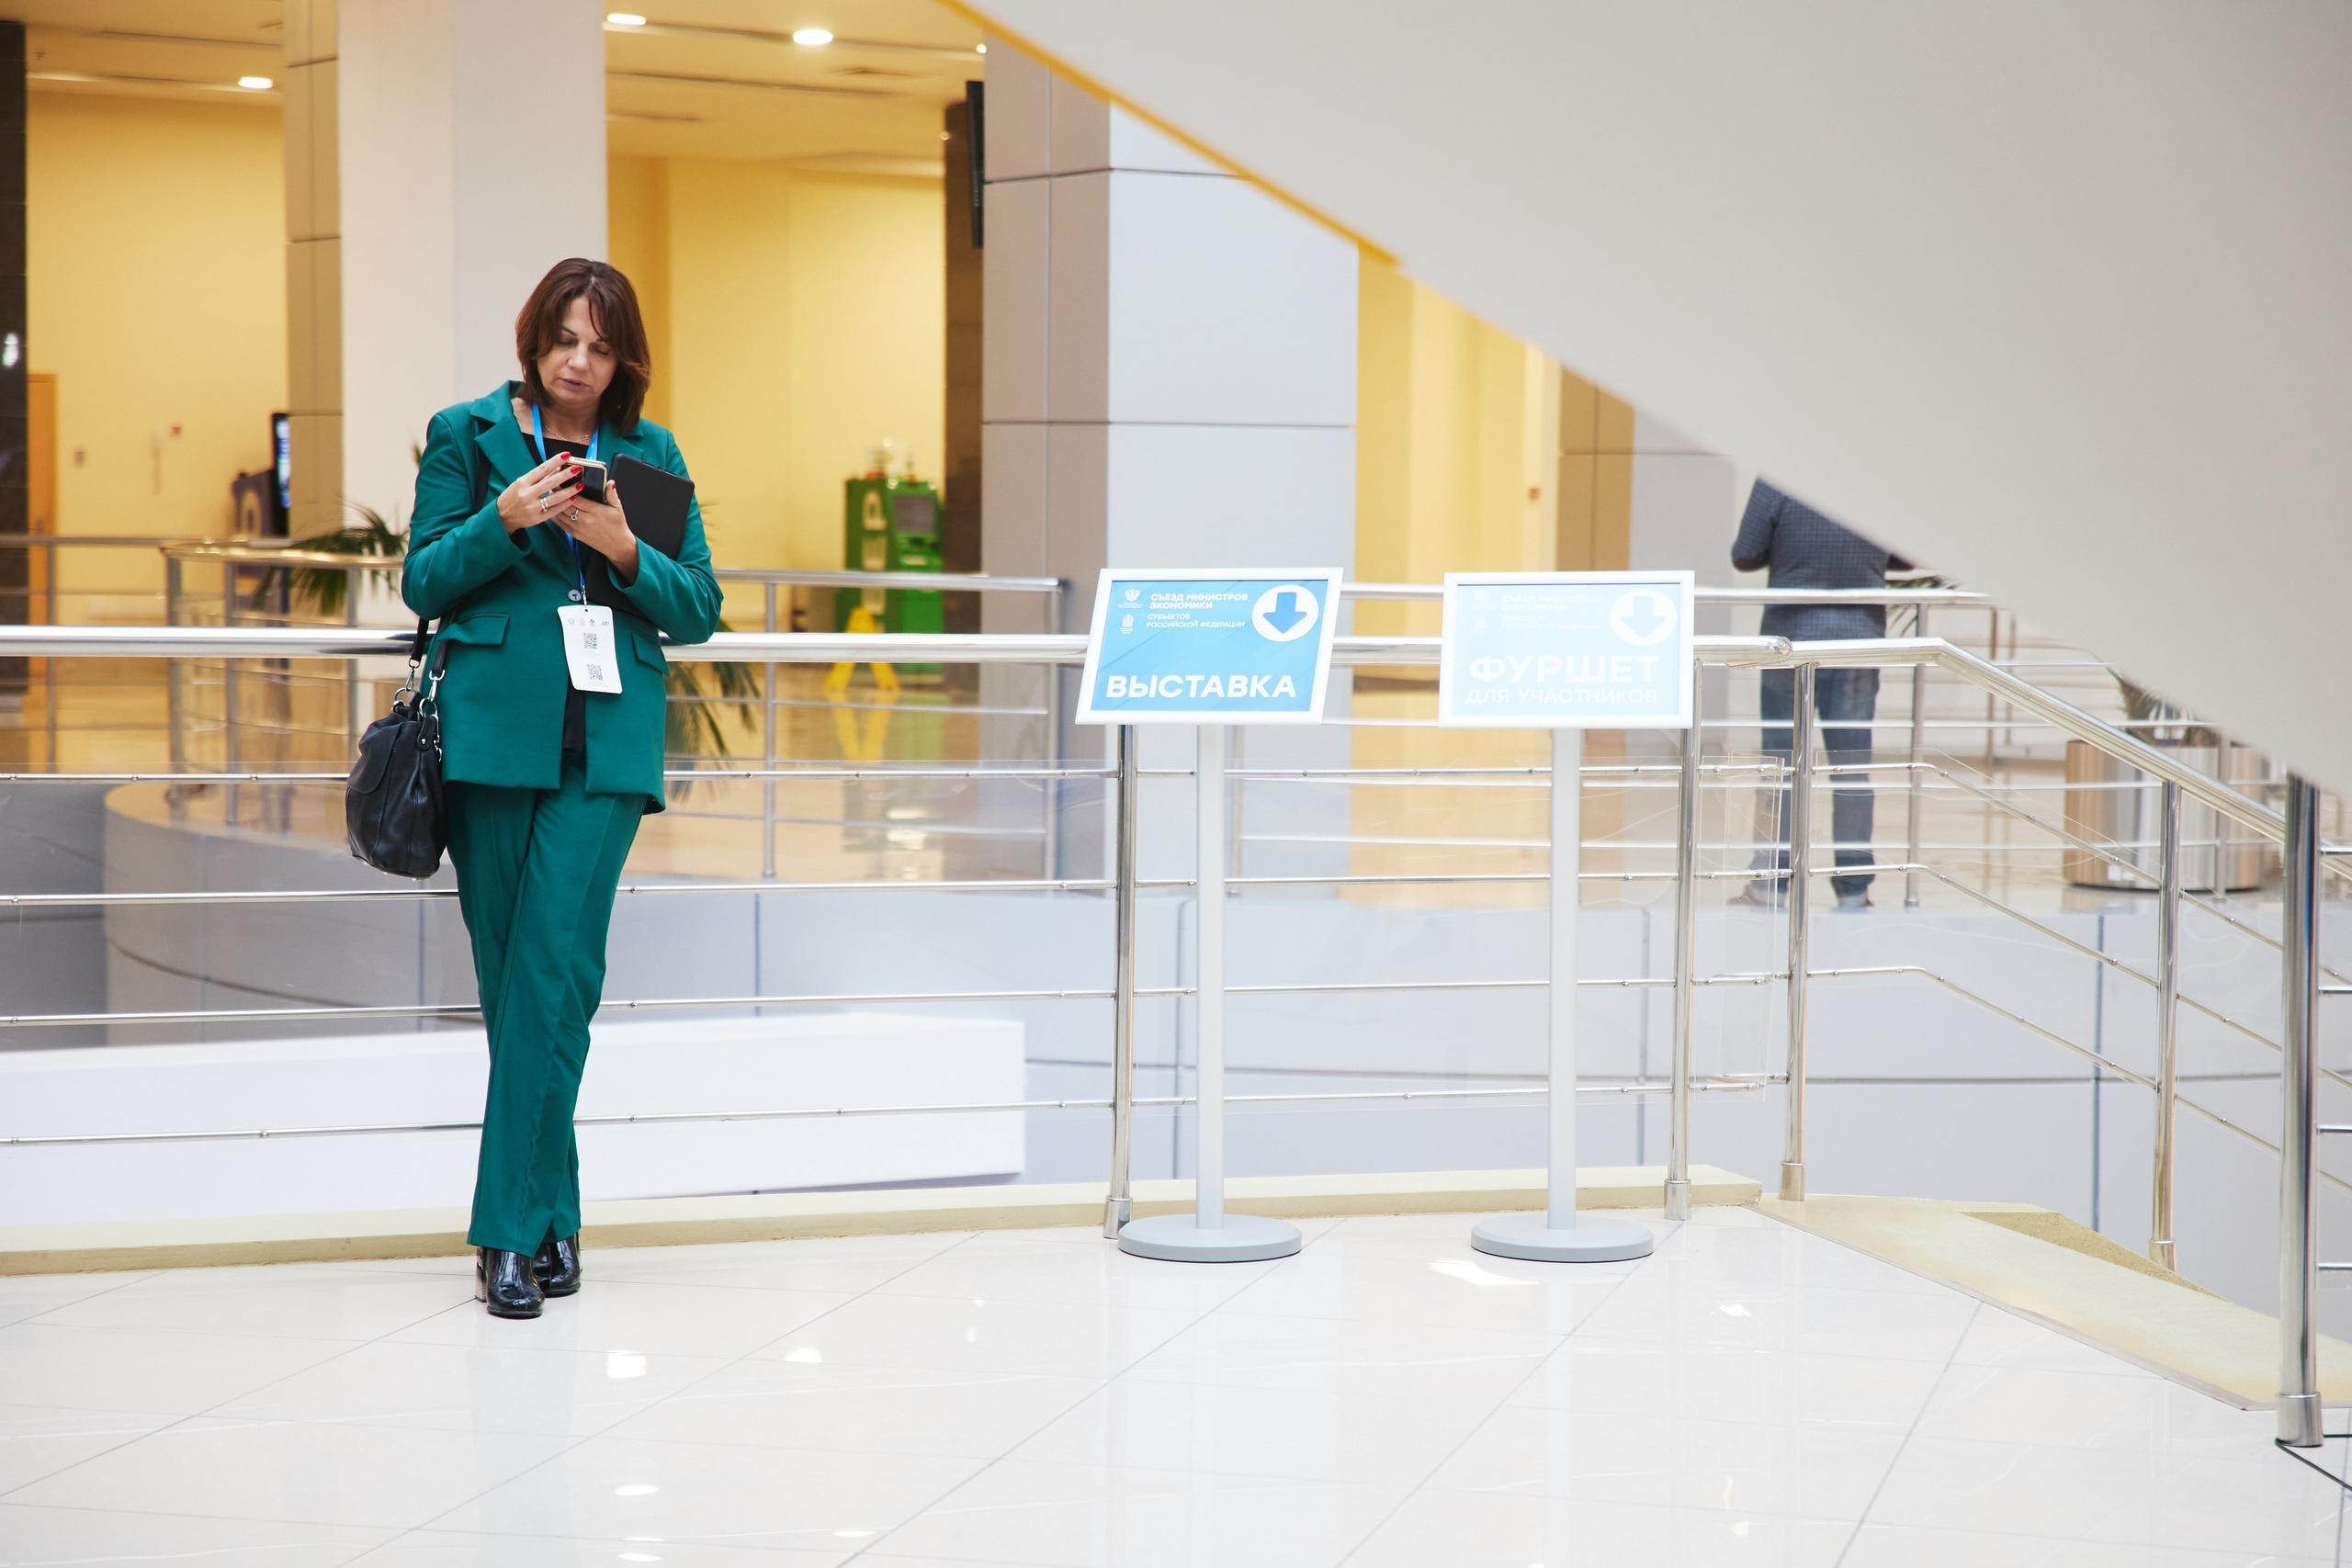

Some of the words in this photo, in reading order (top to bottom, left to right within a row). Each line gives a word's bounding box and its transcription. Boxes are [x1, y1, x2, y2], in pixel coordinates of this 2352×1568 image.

[1150, 593, 1183, 602] СЪЕЗД
[1469, 655, 1660, 683] ФУРШЕТ
[1106, 675, 1296, 698] ВЫСТАВКА
[1465, 689, 1509, 705] ДЛЯ
[1517, 689, 1657, 704] УЧАСТНИКОВ
